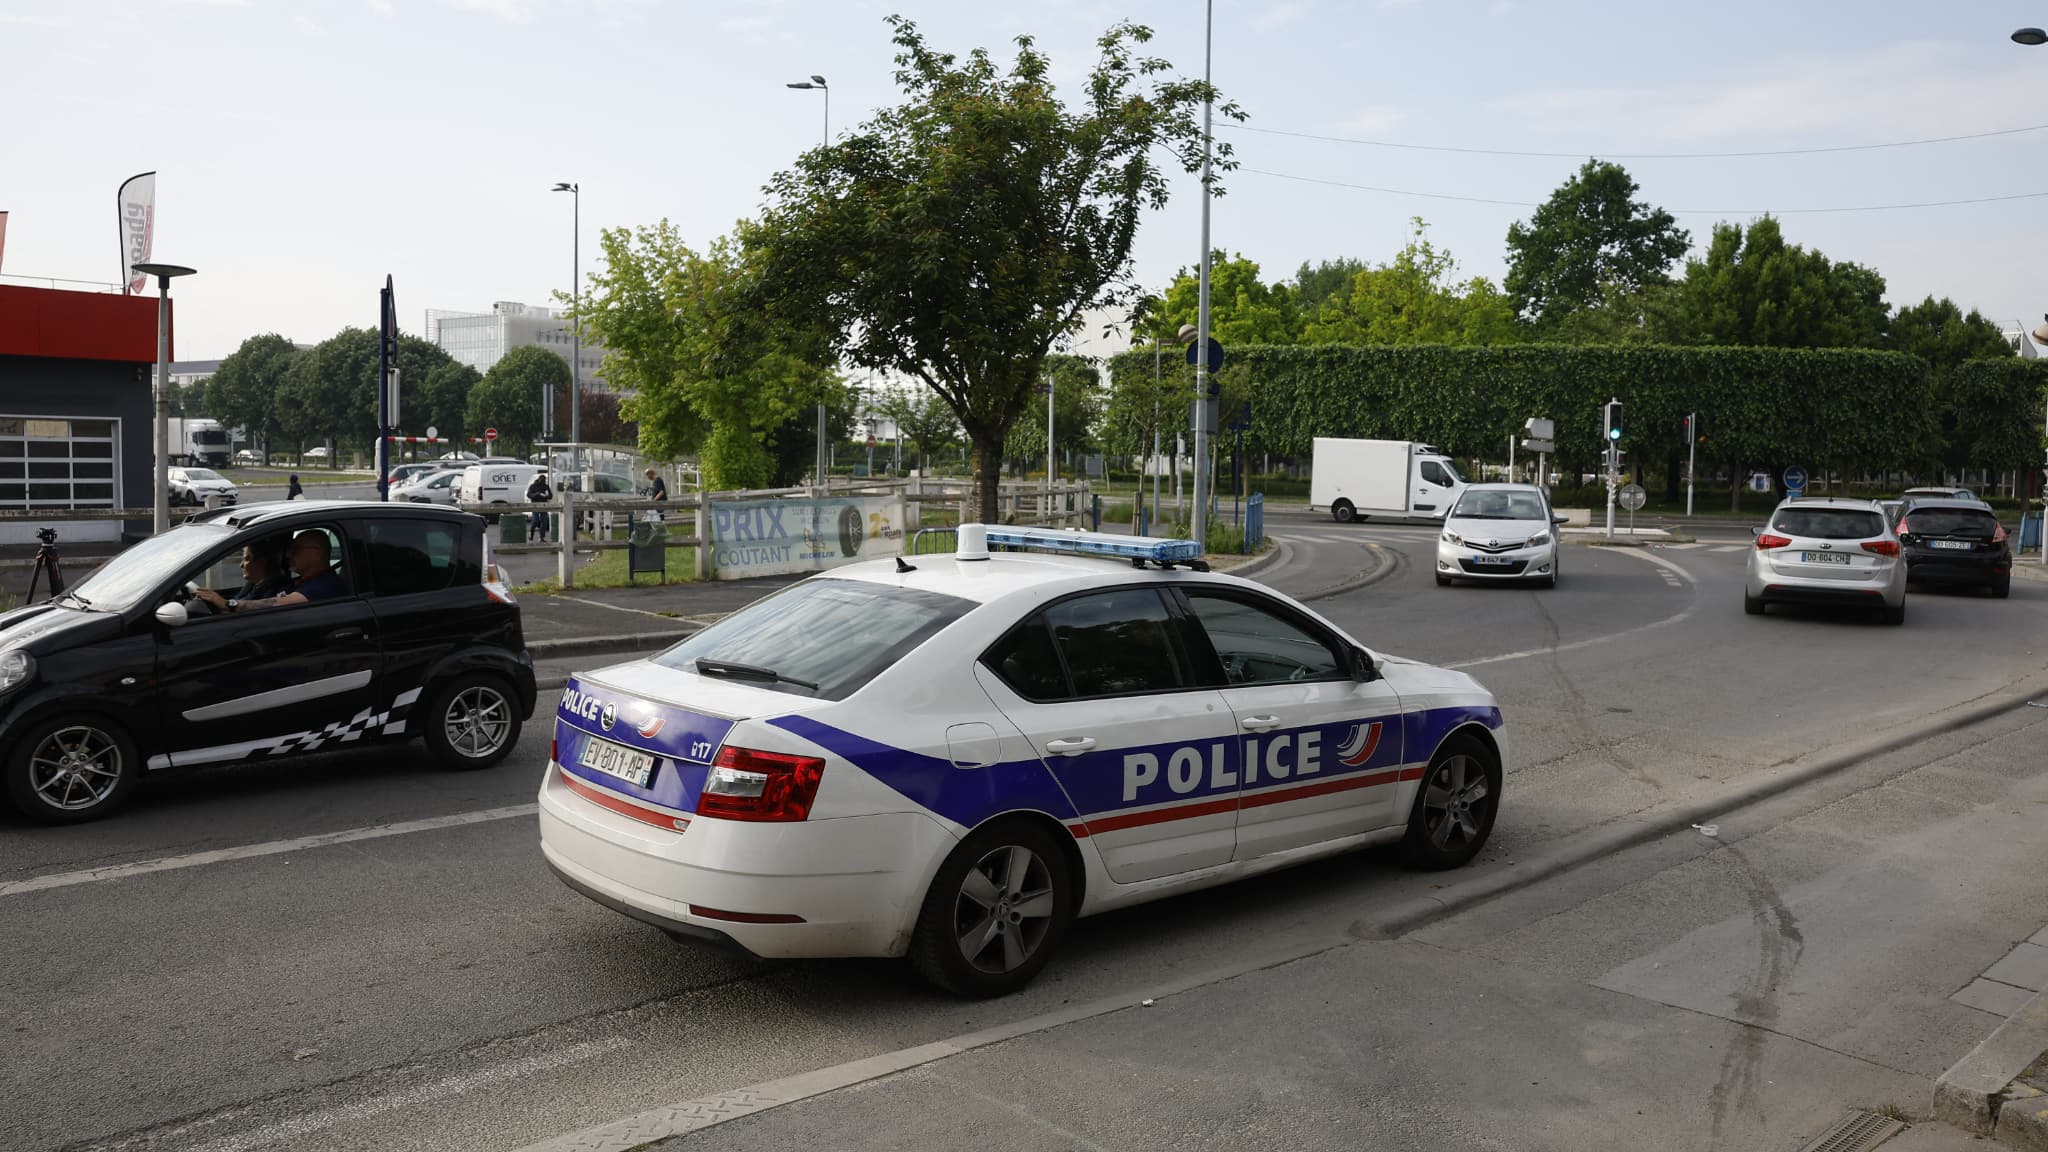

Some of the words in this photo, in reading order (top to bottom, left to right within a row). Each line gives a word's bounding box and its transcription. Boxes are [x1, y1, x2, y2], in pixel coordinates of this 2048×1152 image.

[714, 504, 788, 543] PRIX
[717, 545, 791, 567] COÛTANT
[560, 687, 603, 721] POLICE
[698, 742, 712, 759] 17
[1122, 730, 1322, 802] POLICE
